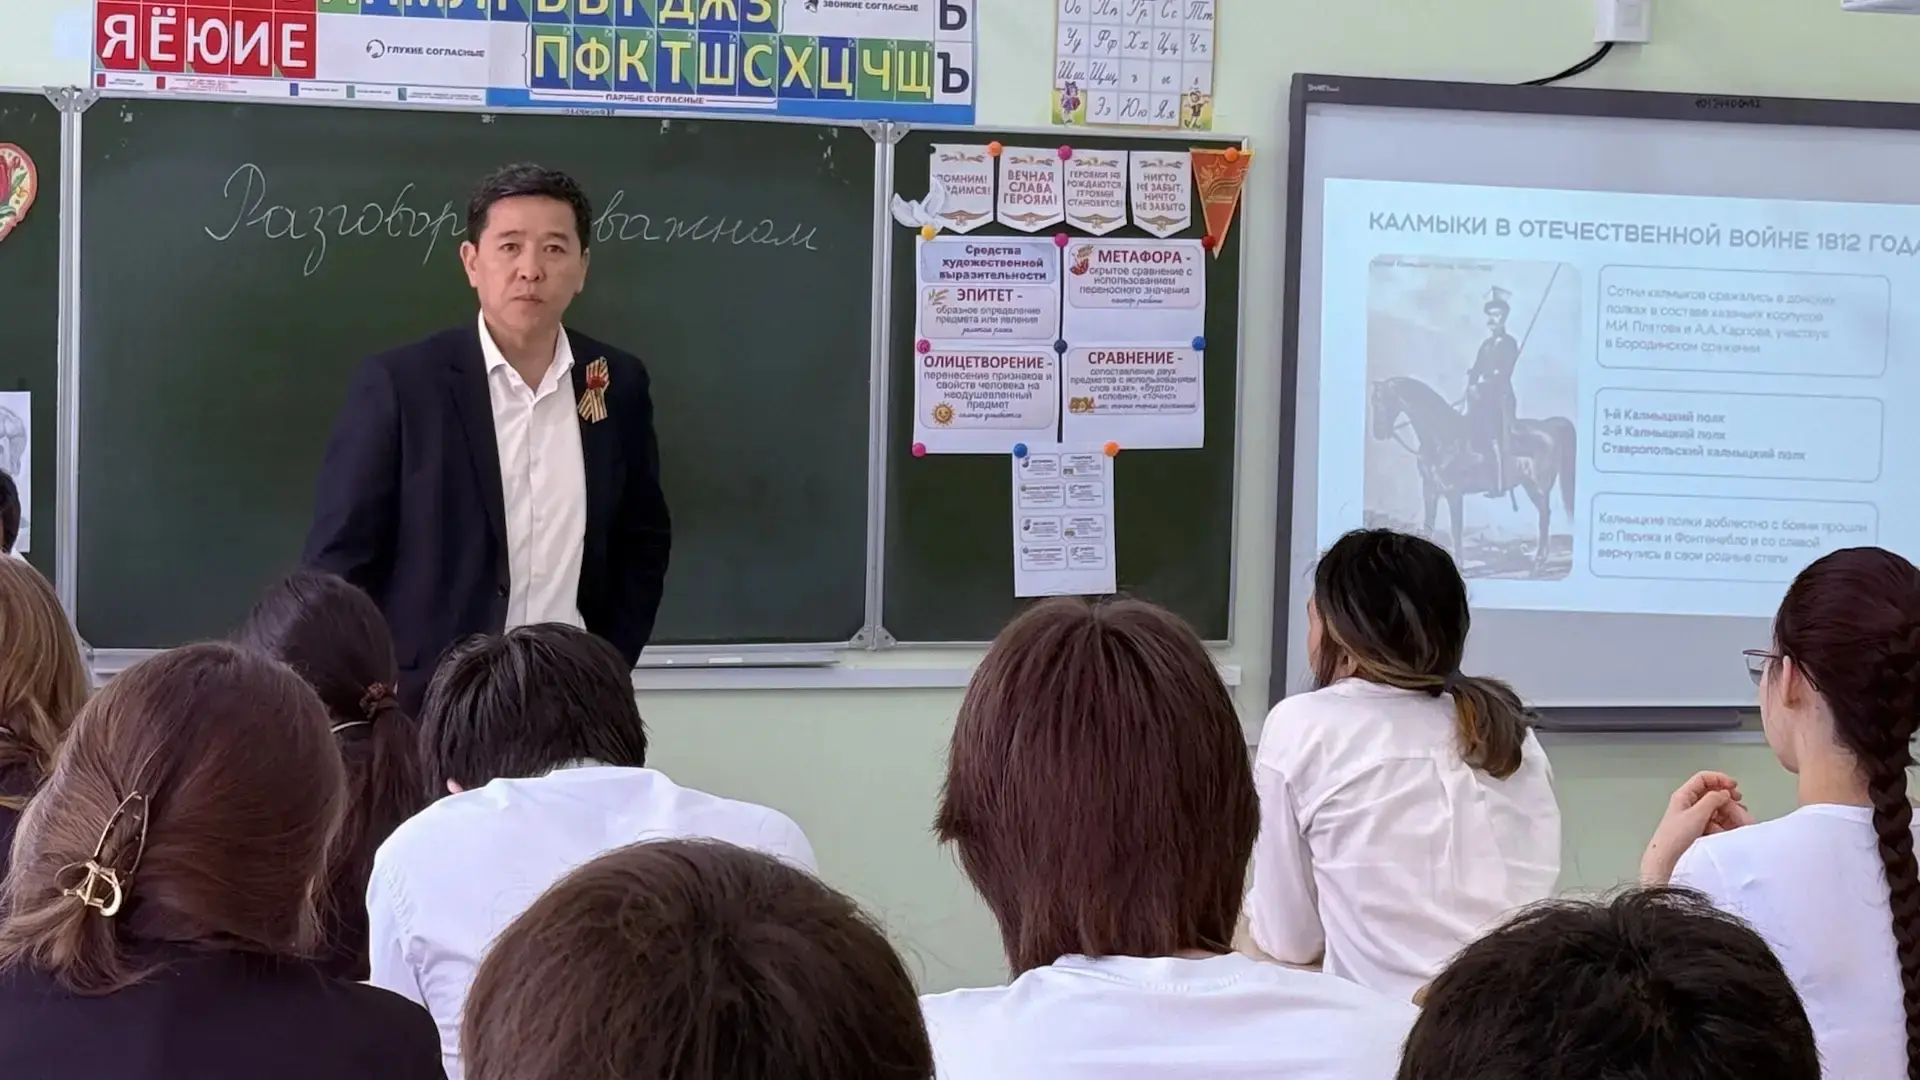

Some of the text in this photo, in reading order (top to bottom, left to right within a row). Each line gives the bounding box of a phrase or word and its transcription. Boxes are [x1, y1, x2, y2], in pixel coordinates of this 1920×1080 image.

[823, 0, 919, 12] ЗВОНКИЕ СОГЛАСНЫЕ
[387, 46, 485, 58] ГЛУХИЕ СОГЛАСНЫЕ
[605, 94, 704, 104] ПАРНЫЕ СОГЛАСНЫЕ
[1008, 170, 1054, 182] ВЕЧНАЯ
[1144, 174, 1177, 182] НИКТО
[1009, 182, 1052, 194] СЛАВА
[1137, 183, 1148, 191] НЕ
[1004, 194, 1058, 205] ГЕРОЯМ!
[1144, 193, 1176, 202] НИЧТО
[1136, 202, 1186, 212] НЕ ЗАБЫТО
[595, 190, 818, 251] важном
[1369, 212, 1487, 235] КАЛМЫКИ
[1496, 218, 1510, 236] В
[1519, 218, 1721, 246] ОТЕЧЕСТВЕННОЙ
[1730, 226, 1809, 250] ВОЙНЕ
[1816, 232, 1861, 252] 1812
[966, 244, 1022, 256] Средства
[1098, 250, 1182, 264] МЕТАФОРА
[942, 258, 1044, 268] художественной
[939, 271, 1046, 281] выразительности
[1089, 268, 1192, 276] скрытое сравнение с
[1094, 277, 1176, 285] использованием
[957, 288, 1014, 302] ЭПИТЕТ
[1080, 286, 1190, 295] переносного значения
[1607, 285, 1646, 297] Сотни
[936, 305, 1041, 316] образное определение
[1606, 304, 1647, 315] полках
[936, 316, 1038, 325] предмета или явления
[924, 356, 1044, 370] ОЛИЦЕТВОРЕНИЕ
[1088, 352, 1174, 364] СРАВНЕНИЕ
[924, 372, 990, 382] перенесение
[992, 372, 1044, 383] признаков
[1090, 368, 1176, 377] сопоставление двух
[936, 381, 1040, 390] свойств человека на
[1070, 377, 1116, 385] предметов
[944, 390, 1032, 400] неодушевленный
[966, 401, 1010, 410] предмет
[1604, 408, 1726, 423] 1-й Калмыцкий полк
[1602, 424, 1726, 440] 2-й Калмыцкий полк
[1602, 442, 1806, 461] Ставропольский калмыцкий полк
[1599, 511, 1664, 526] Калмыцкие
[1667, 516, 1702, 527] полки
[1704, 516, 1768, 530] доблестно
[1771, 521, 1779, 530] с
[1598, 532, 1614, 542] до
[1664, 533, 1672, 542] и
[1761, 537, 1776, 547] со
